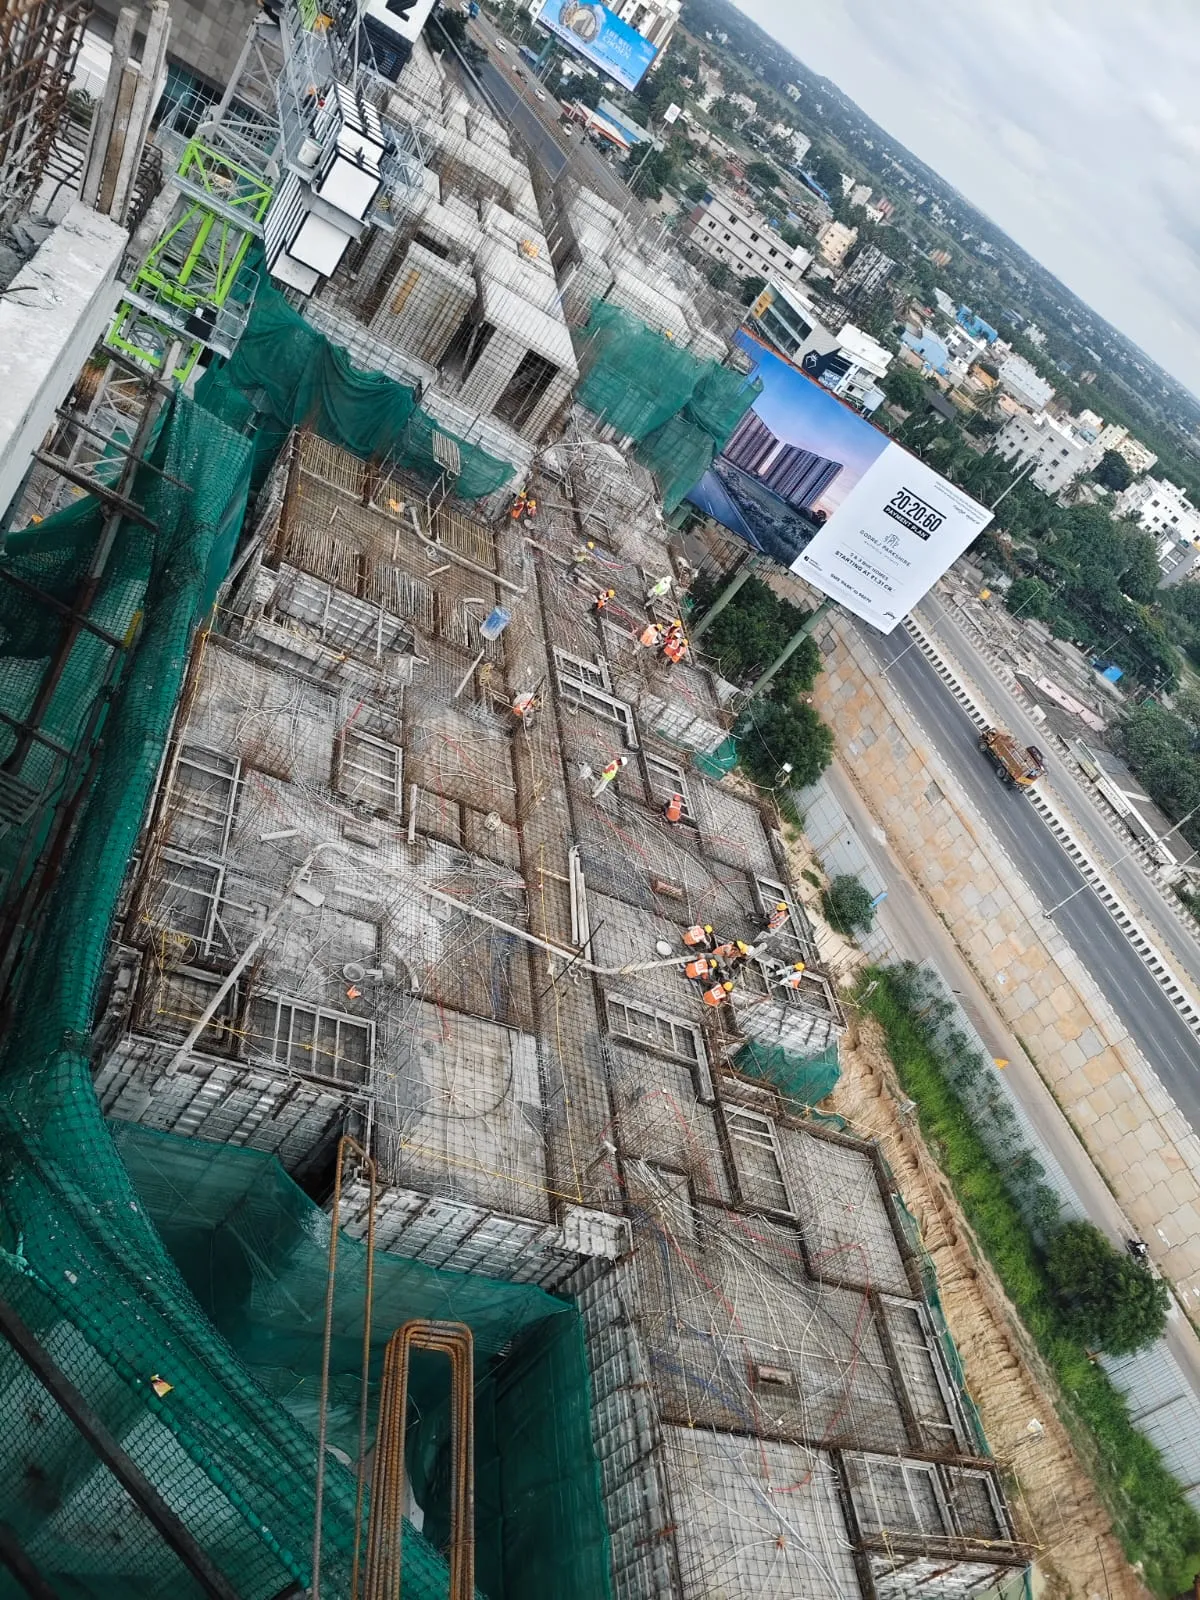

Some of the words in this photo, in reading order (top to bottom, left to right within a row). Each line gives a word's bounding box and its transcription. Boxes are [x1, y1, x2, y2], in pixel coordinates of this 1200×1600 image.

[602, 34, 631, 60] CHOSEN
[885, 505, 912, 530] PAYMENT
[890, 490, 943, 532] 20:20:60
[835, 550, 863, 572] STARTING
[862, 568, 870, 577] AT
[882, 544, 911, 567] PARKSHIRE
[872, 565, 889, 581] HOMES
